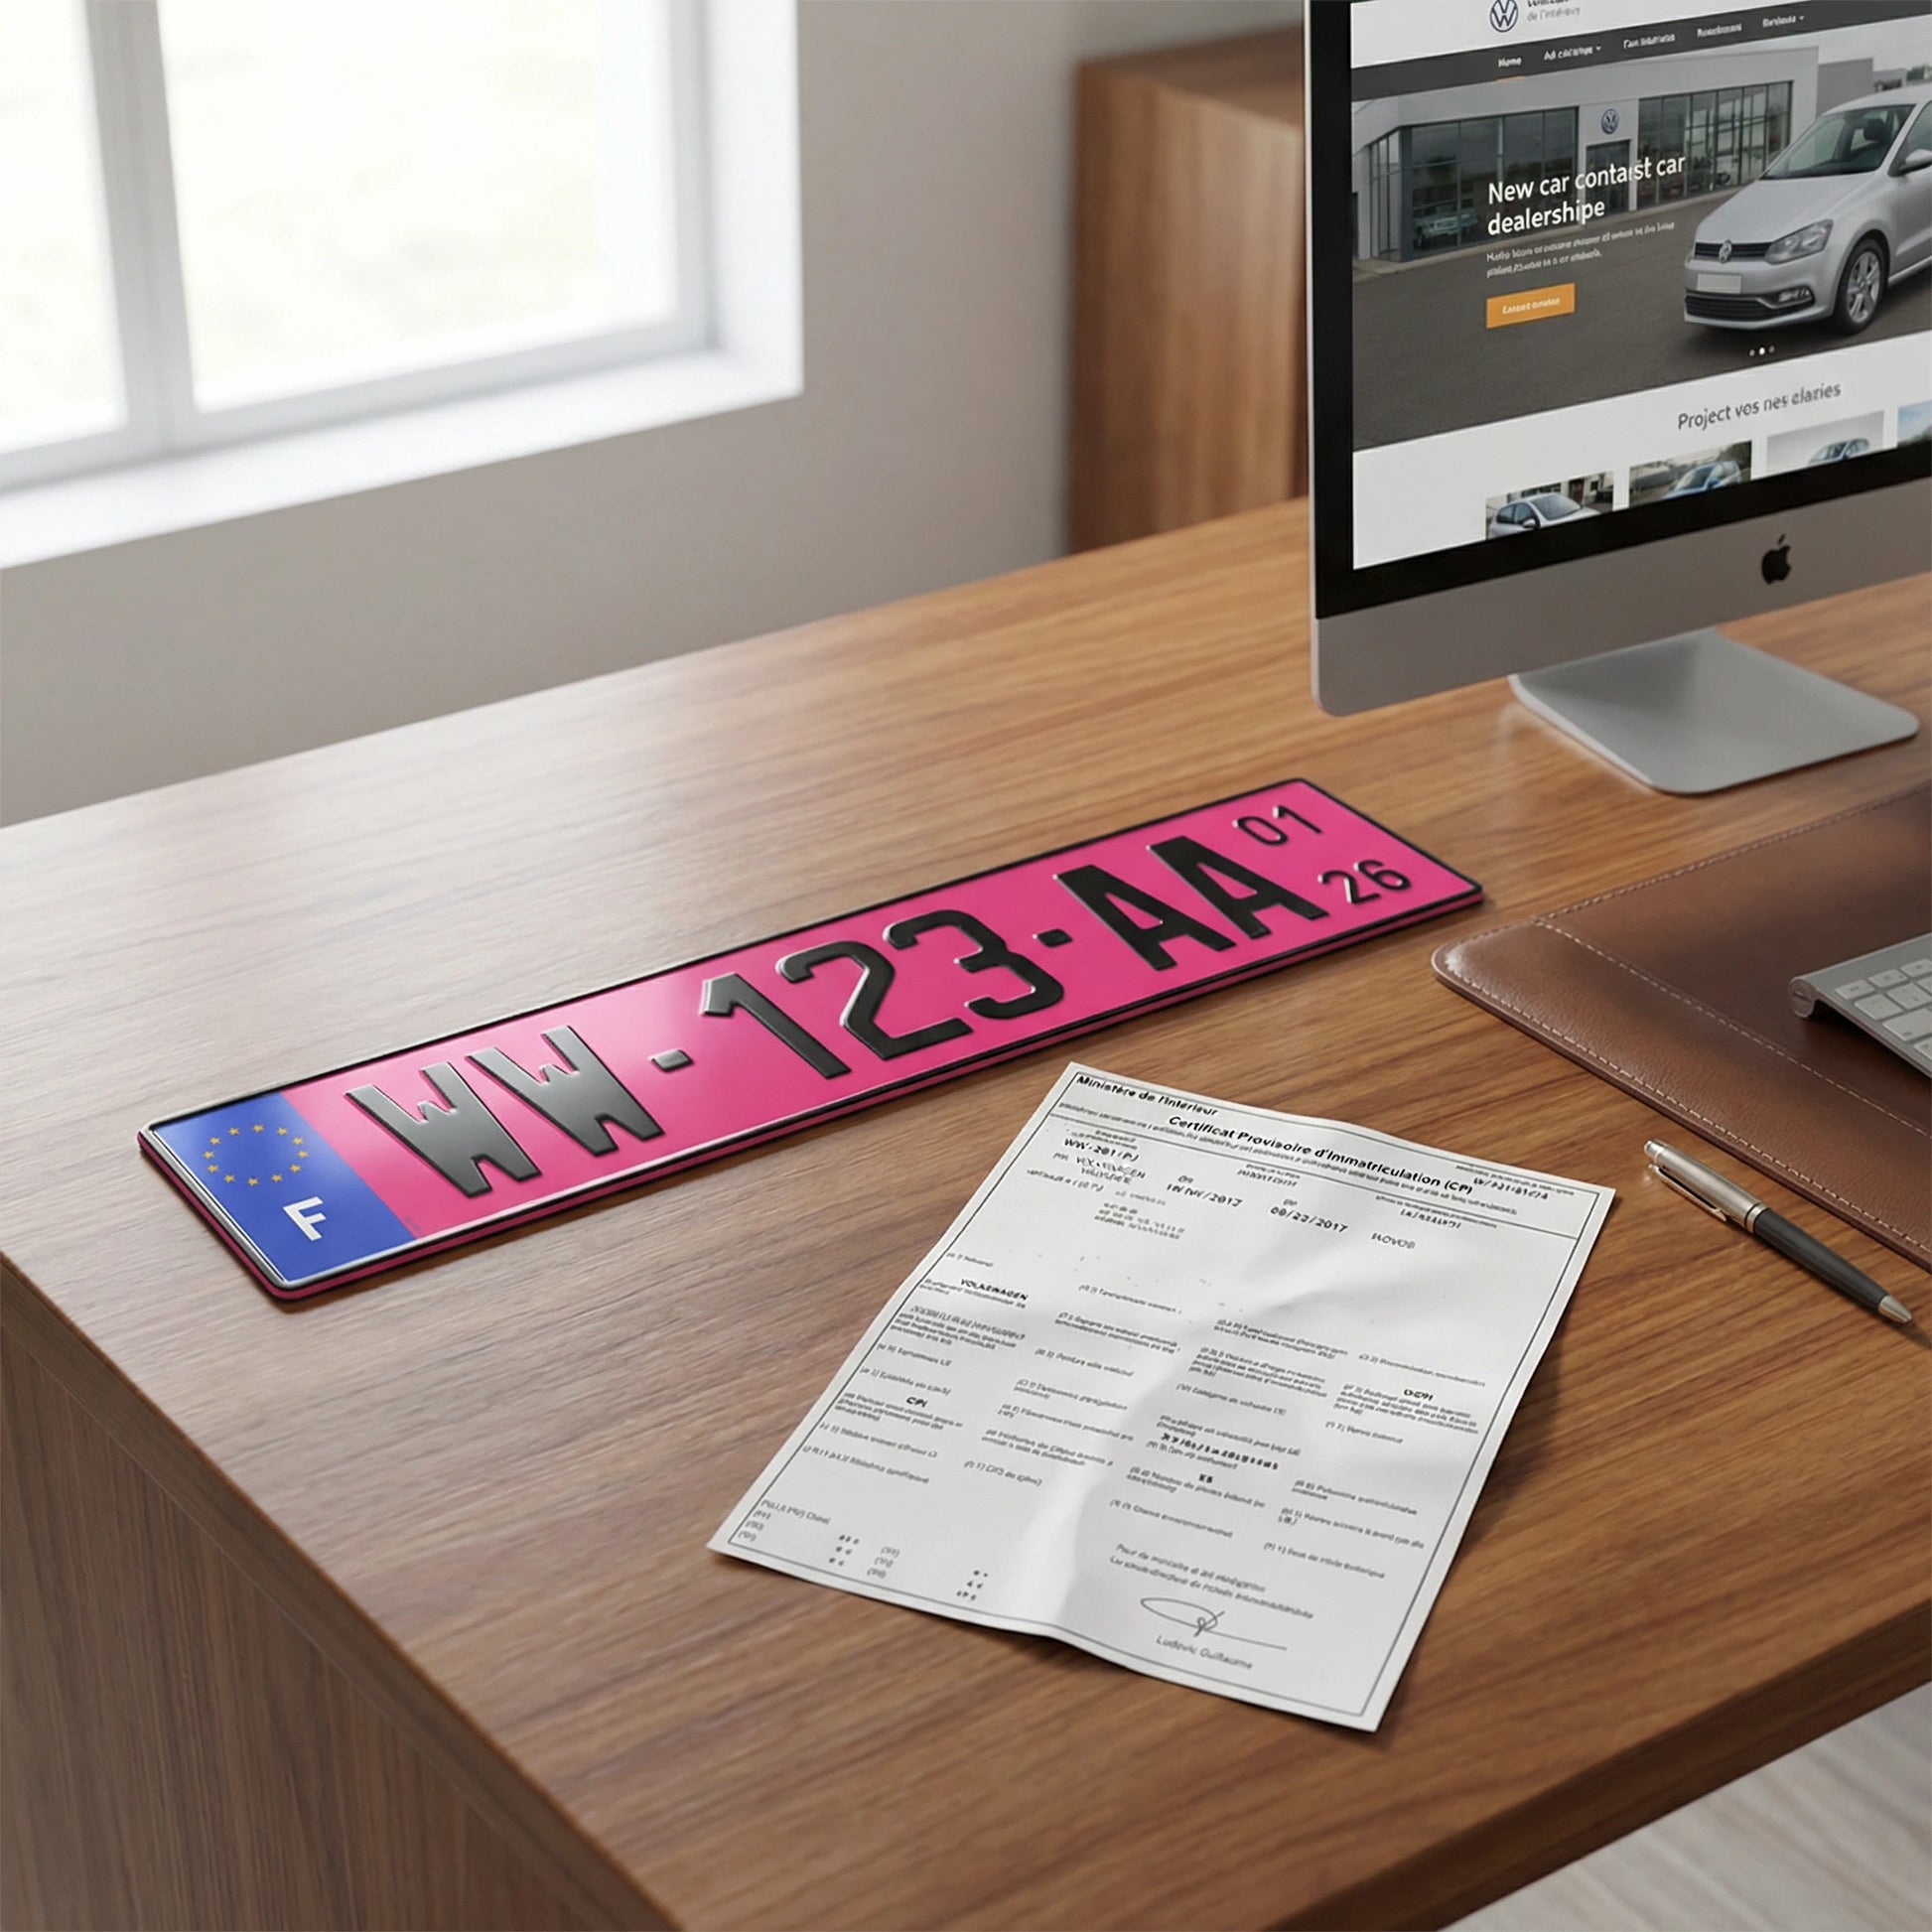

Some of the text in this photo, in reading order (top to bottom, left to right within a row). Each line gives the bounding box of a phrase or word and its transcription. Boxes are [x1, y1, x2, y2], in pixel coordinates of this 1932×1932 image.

[1489, 181, 1535, 205] New
[1539, 175, 1571, 197] car
[1656, 156, 1687, 177] car
[1488, 200, 1606, 236] dealershipe
[1678, 405, 1731, 431] Project
[1735, 400, 1759, 419] vos
[1233, 804, 1322, 846] 01
[1317, 860, 1412, 905] 26
[1139, 1090, 1157, 1102] de
[1169, 1116, 1235, 1140] Certificat
[283, 1196, 328, 1241] F
